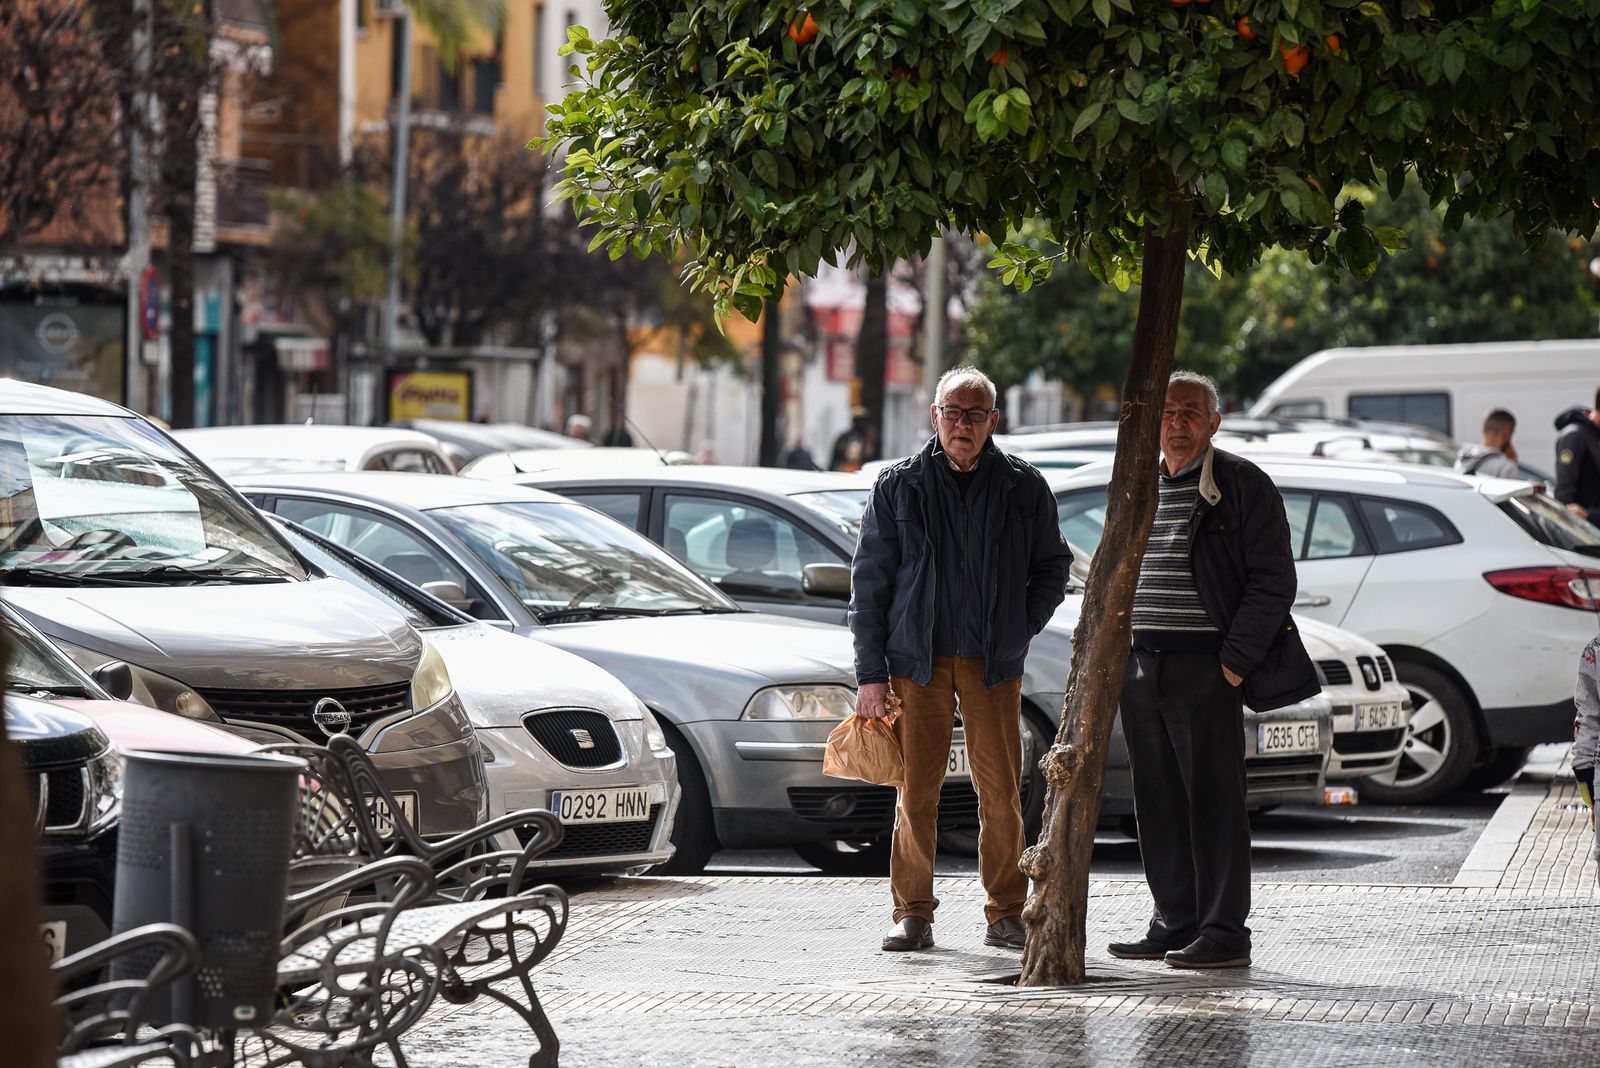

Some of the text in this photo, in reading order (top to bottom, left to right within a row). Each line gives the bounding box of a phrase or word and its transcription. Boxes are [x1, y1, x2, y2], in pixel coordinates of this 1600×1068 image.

[1266, 726, 1294, 749] 2635
[561, 791, 648, 820] 0292 HNN
